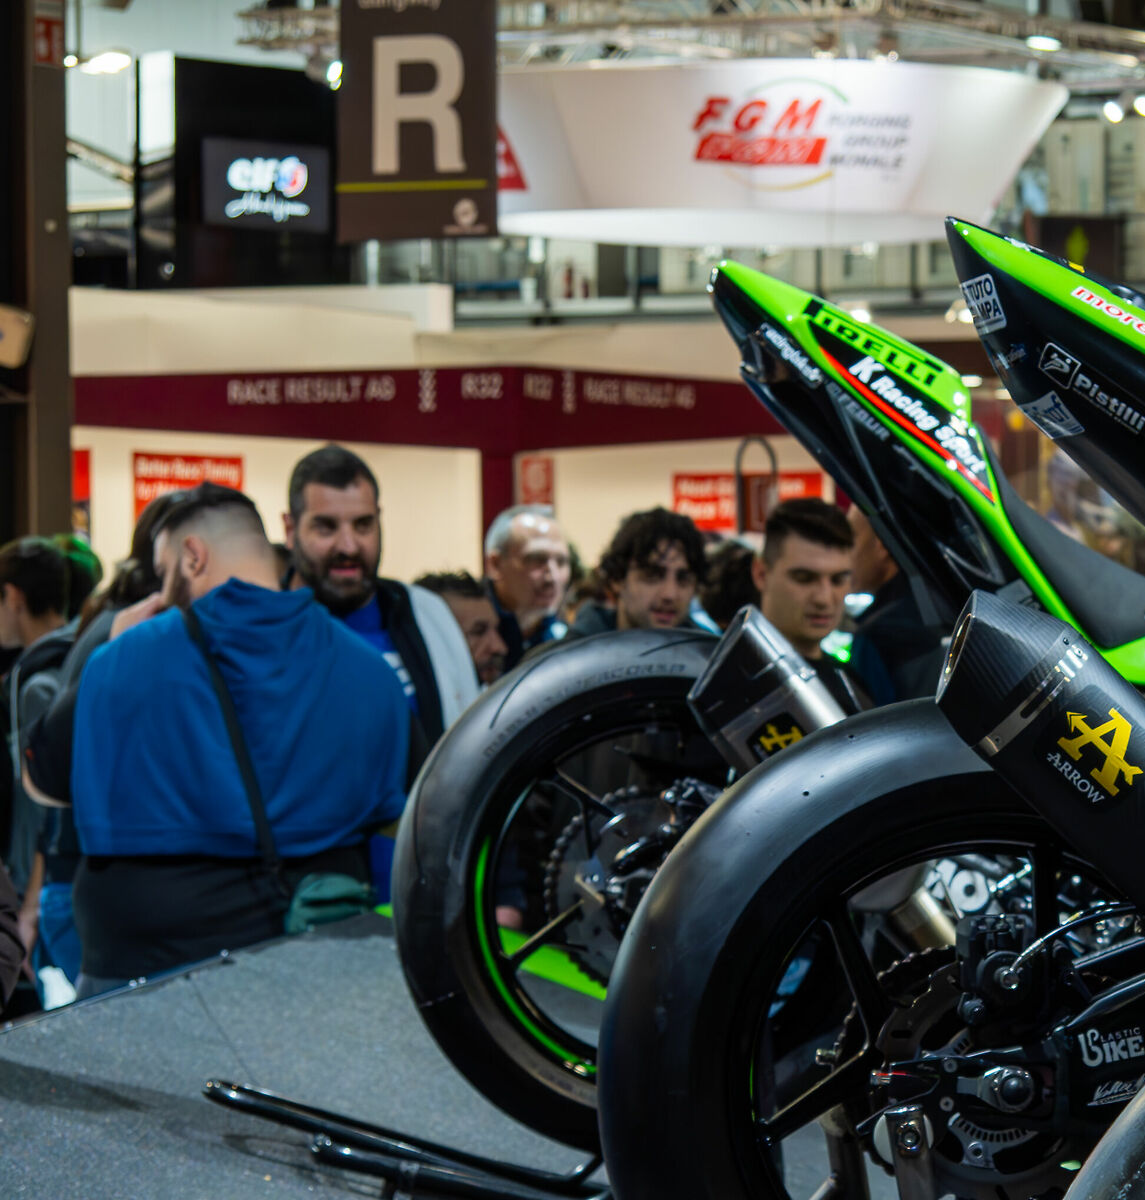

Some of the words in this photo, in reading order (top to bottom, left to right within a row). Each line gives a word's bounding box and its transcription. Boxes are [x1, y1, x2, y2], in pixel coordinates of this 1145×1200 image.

[372, 35, 467, 174] R
[227, 379, 281, 405] RACE
[284, 376, 363, 403] RESULT
[848, 355, 886, 385] K
[869, 373, 941, 432] Racing
[934, 425, 987, 475] Sport
[1046, 752, 1105, 804] ARROW
